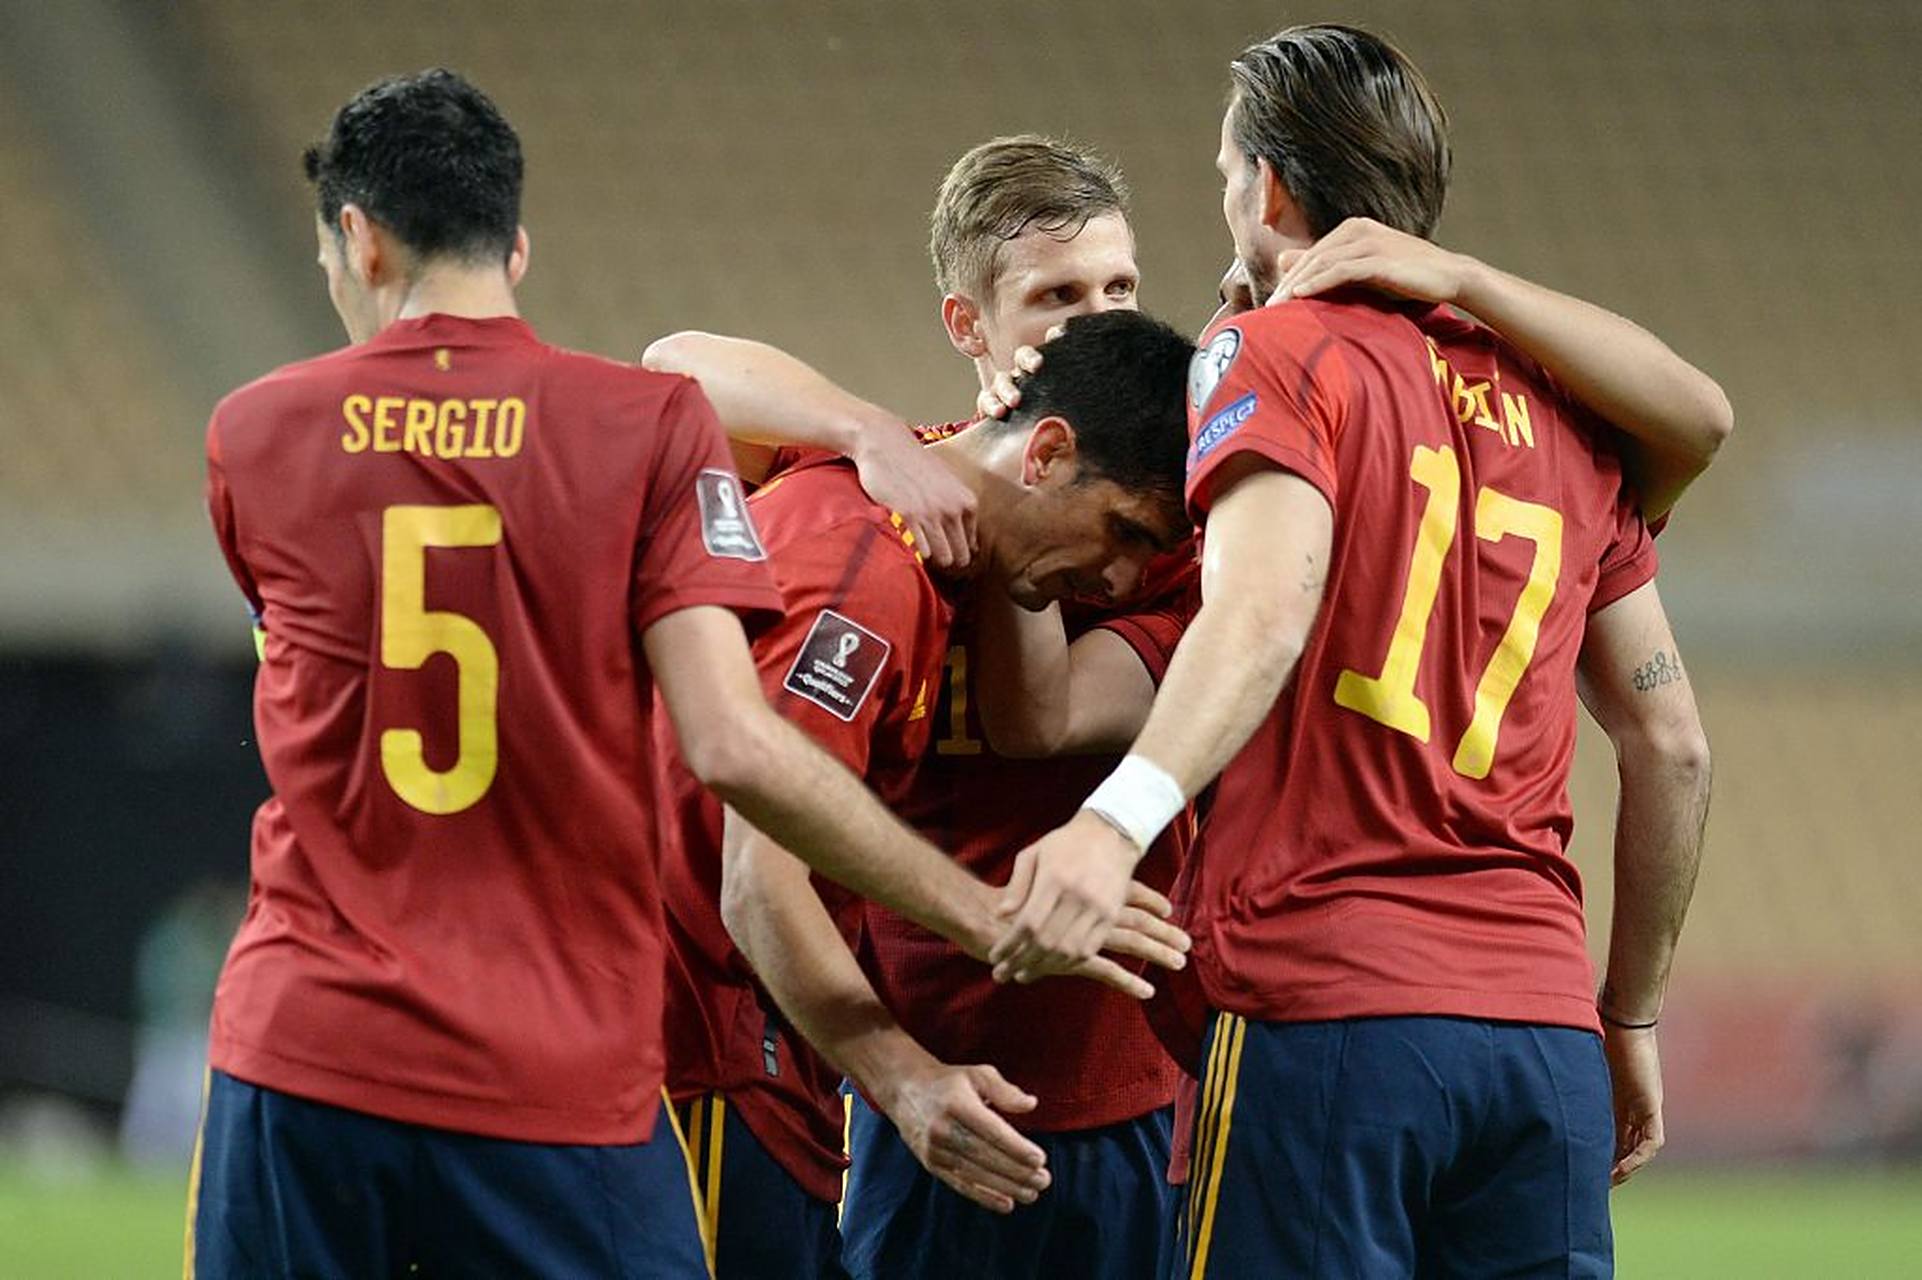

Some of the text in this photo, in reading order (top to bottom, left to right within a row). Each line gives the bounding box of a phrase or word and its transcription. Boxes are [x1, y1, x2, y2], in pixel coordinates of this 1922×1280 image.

[342, 395, 525, 458] SERGIO
[1196, 397, 1257, 452] RESPECT
[381, 506, 501, 814] 5
[1335, 446, 1563, 780] 17
